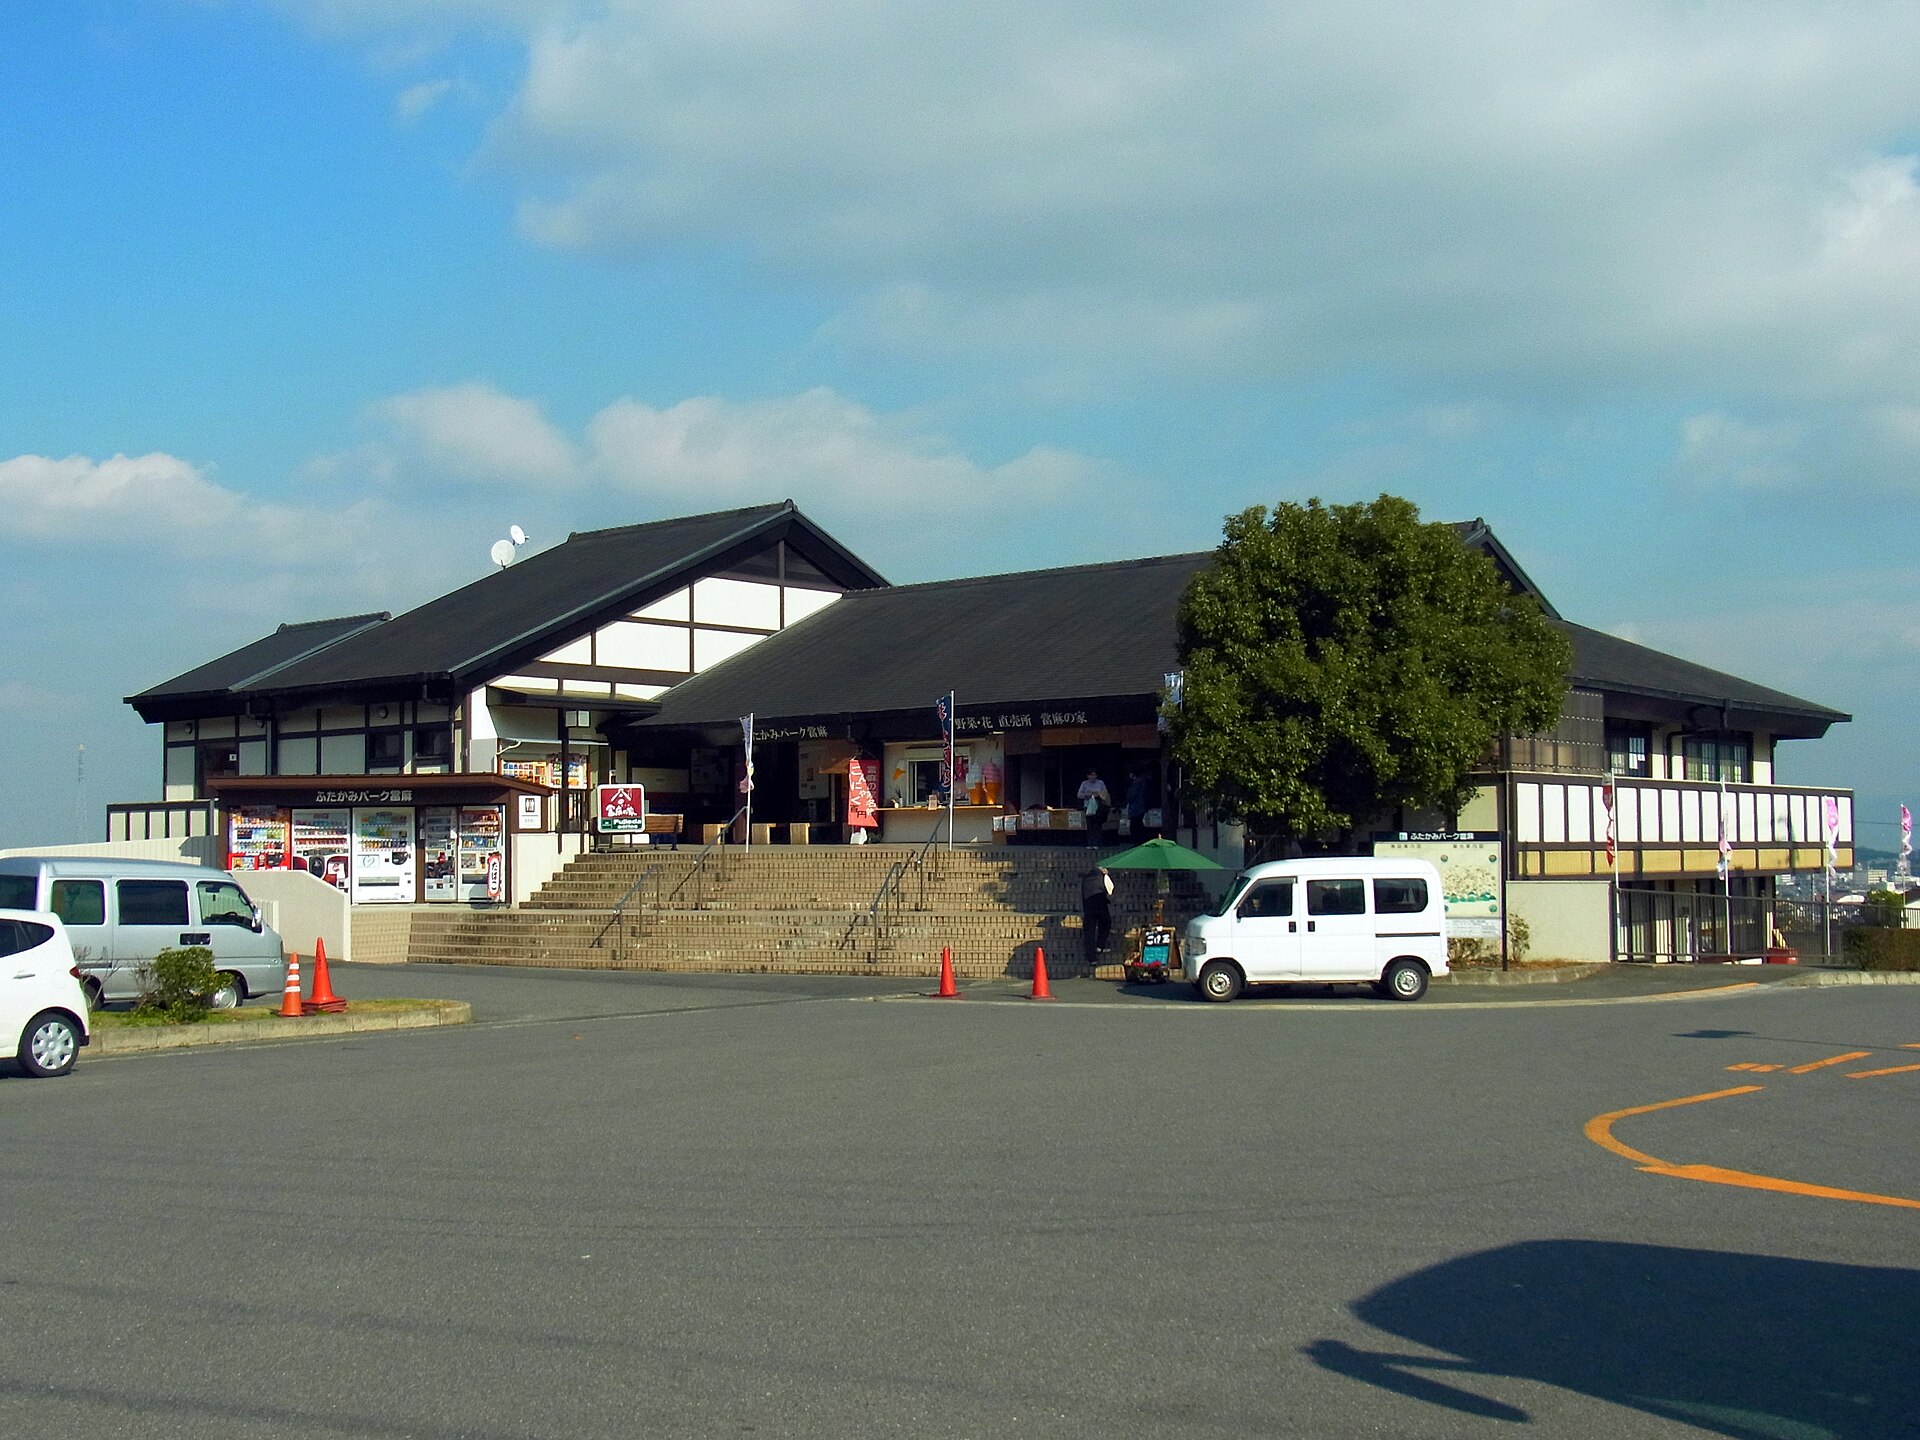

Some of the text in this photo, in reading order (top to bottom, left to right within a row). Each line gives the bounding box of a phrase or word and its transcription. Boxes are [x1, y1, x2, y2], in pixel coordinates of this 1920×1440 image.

[998, 713, 1032, 728] 直売所
[315, 789, 413, 803] ふたかみパーク當麻
